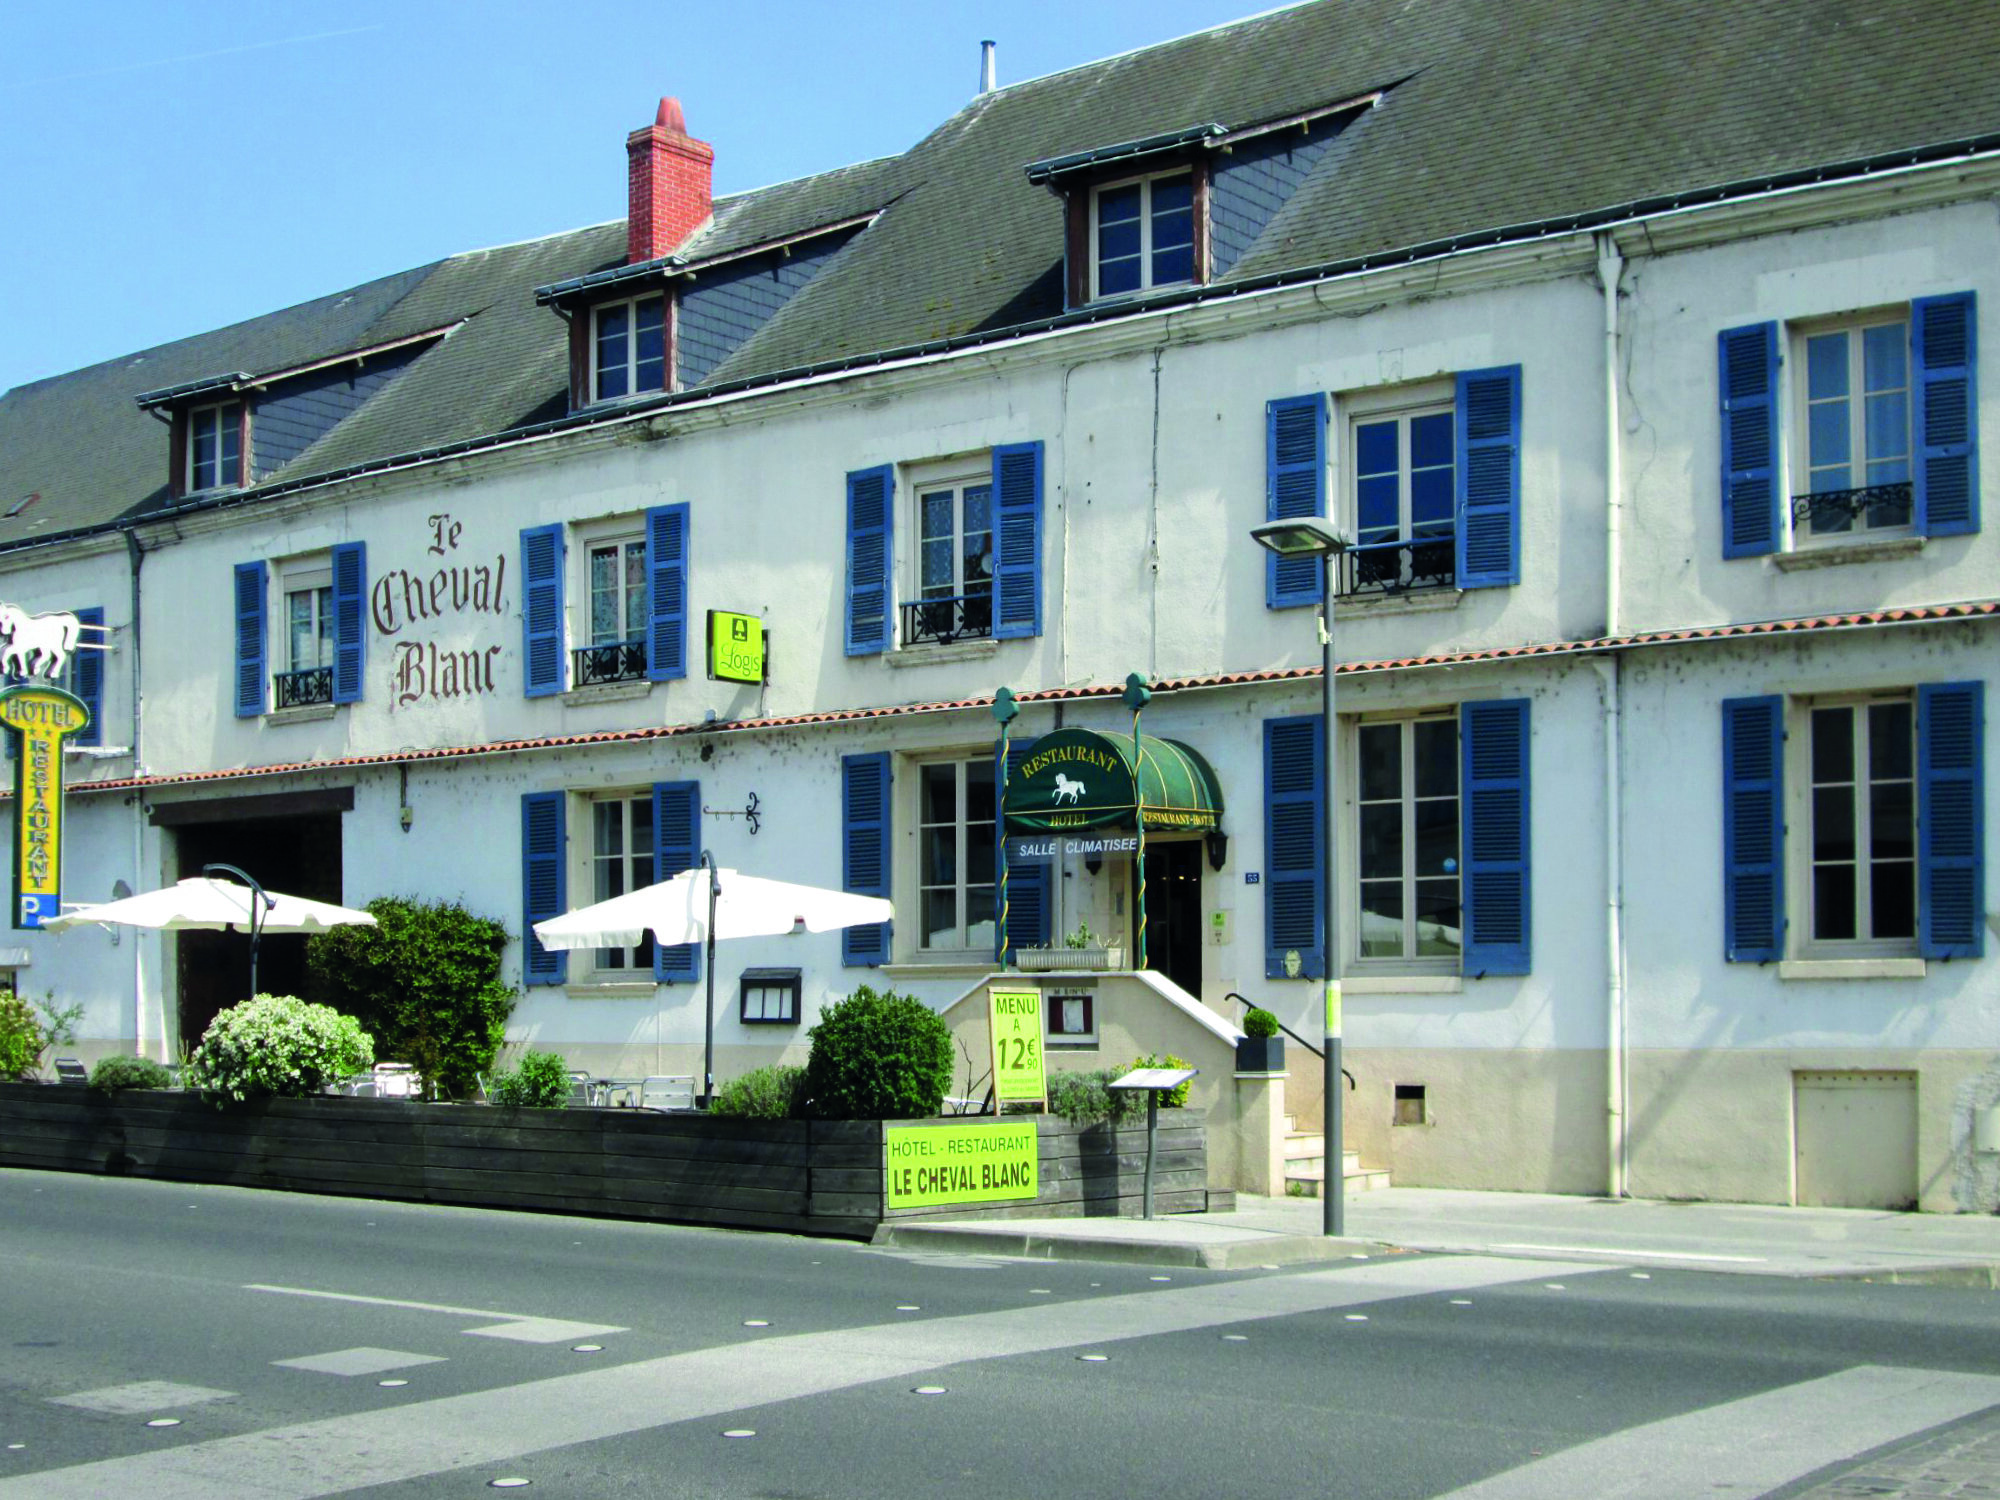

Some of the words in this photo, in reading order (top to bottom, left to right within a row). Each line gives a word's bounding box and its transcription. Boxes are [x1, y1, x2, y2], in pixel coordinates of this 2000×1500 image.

[428, 513, 462, 556] Le
[372, 553, 505, 636] Cheval
[395, 640, 502, 707] Blanc
[720, 642, 760, 677] Logis
[5, 697, 76, 728] HOTEL
[1021, 745, 1118, 779] RESTAURANT
[29, 739, 51, 889] RESTAURANT
[1048, 813, 1089, 827] HOTEL
[1020, 843, 1057, 857] SALLE
[1065, 838, 1138, 854] CLIMATISEE
[1247, 874, 1258, 882] 55
[20, 896, 40, 926] P
[996, 997, 1036, 1015] MENU
[948, 1135, 1031, 1154] RESTAURANT
[894, 1168, 912, 1196] LE
[917, 1165, 977, 1195] CHEVAL
[982, 1160, 1031, 1190] BLANC
